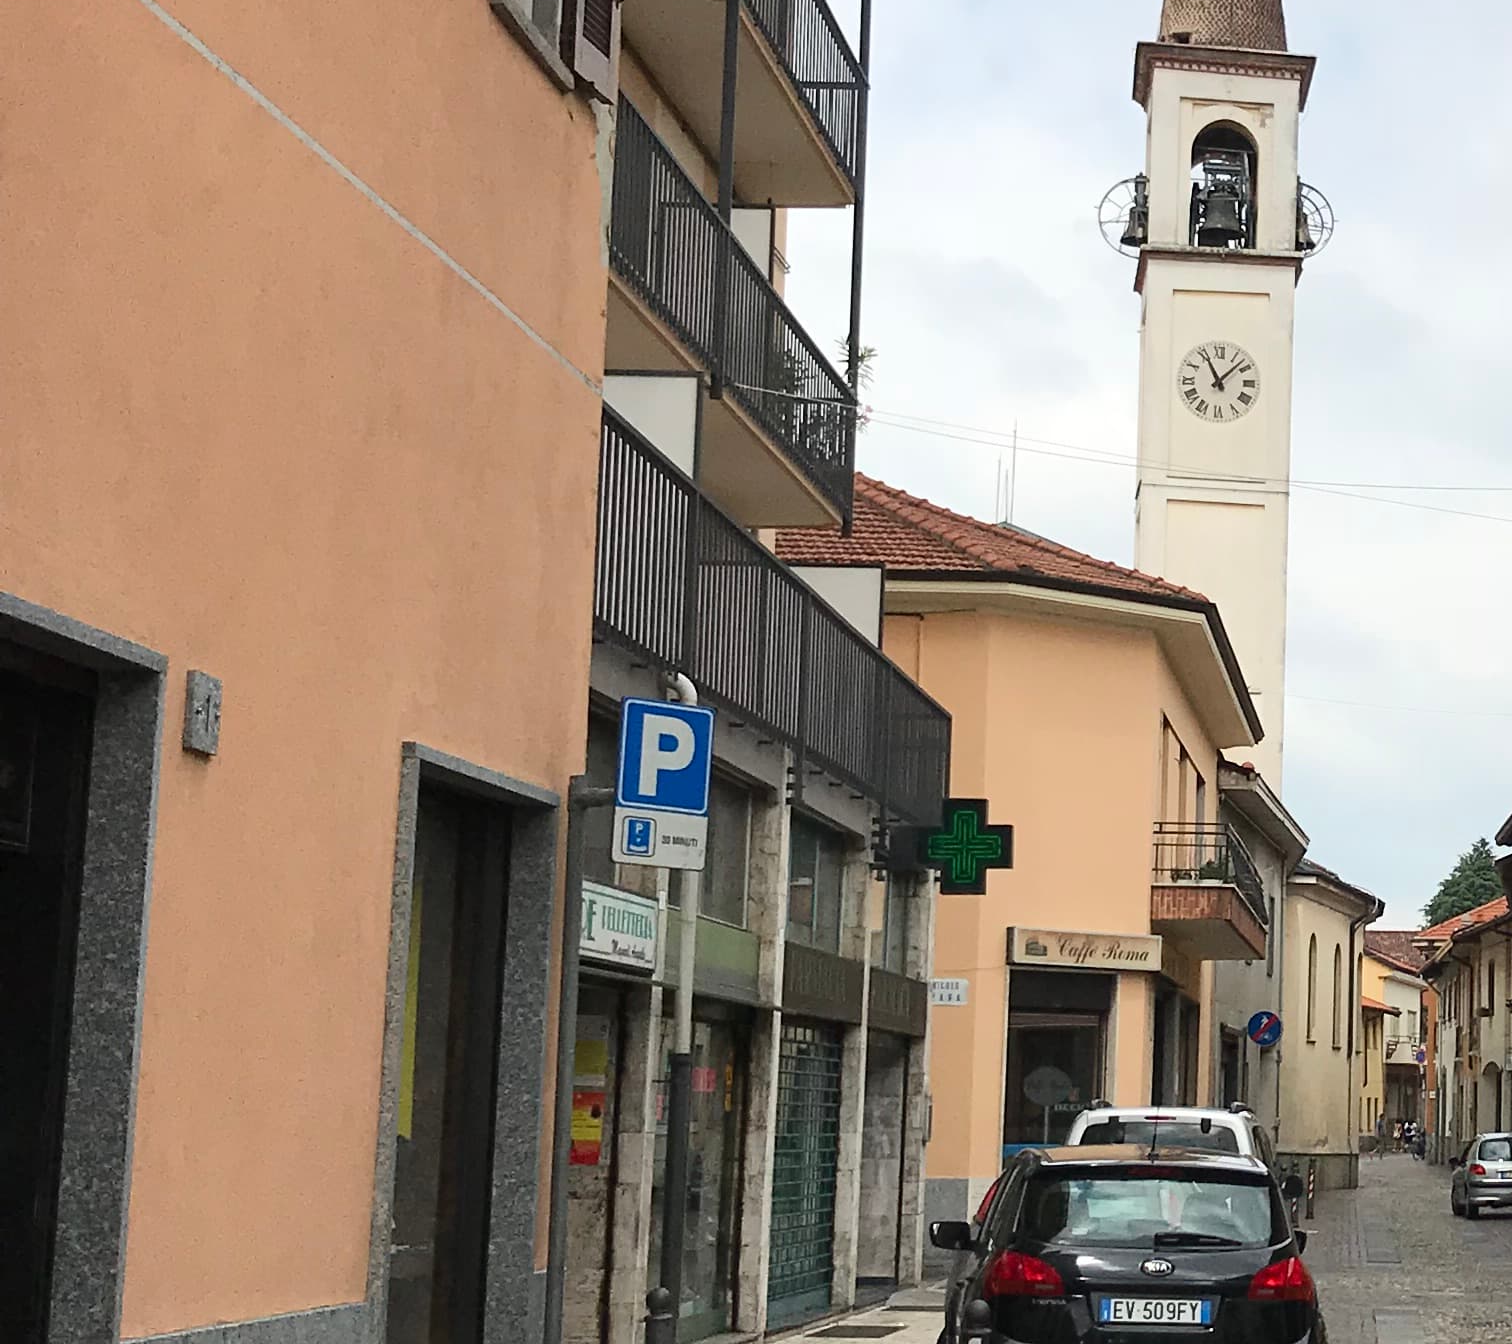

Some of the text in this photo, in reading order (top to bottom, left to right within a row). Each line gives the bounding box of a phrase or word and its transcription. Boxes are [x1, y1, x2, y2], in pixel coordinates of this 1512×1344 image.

[638, 712, 696, 797] P
[1101, 941, 1150, 962] Roma
[1113, 1301, 1136, 1320] EV
[1143, 1302, 1199, 1321] 509FY
